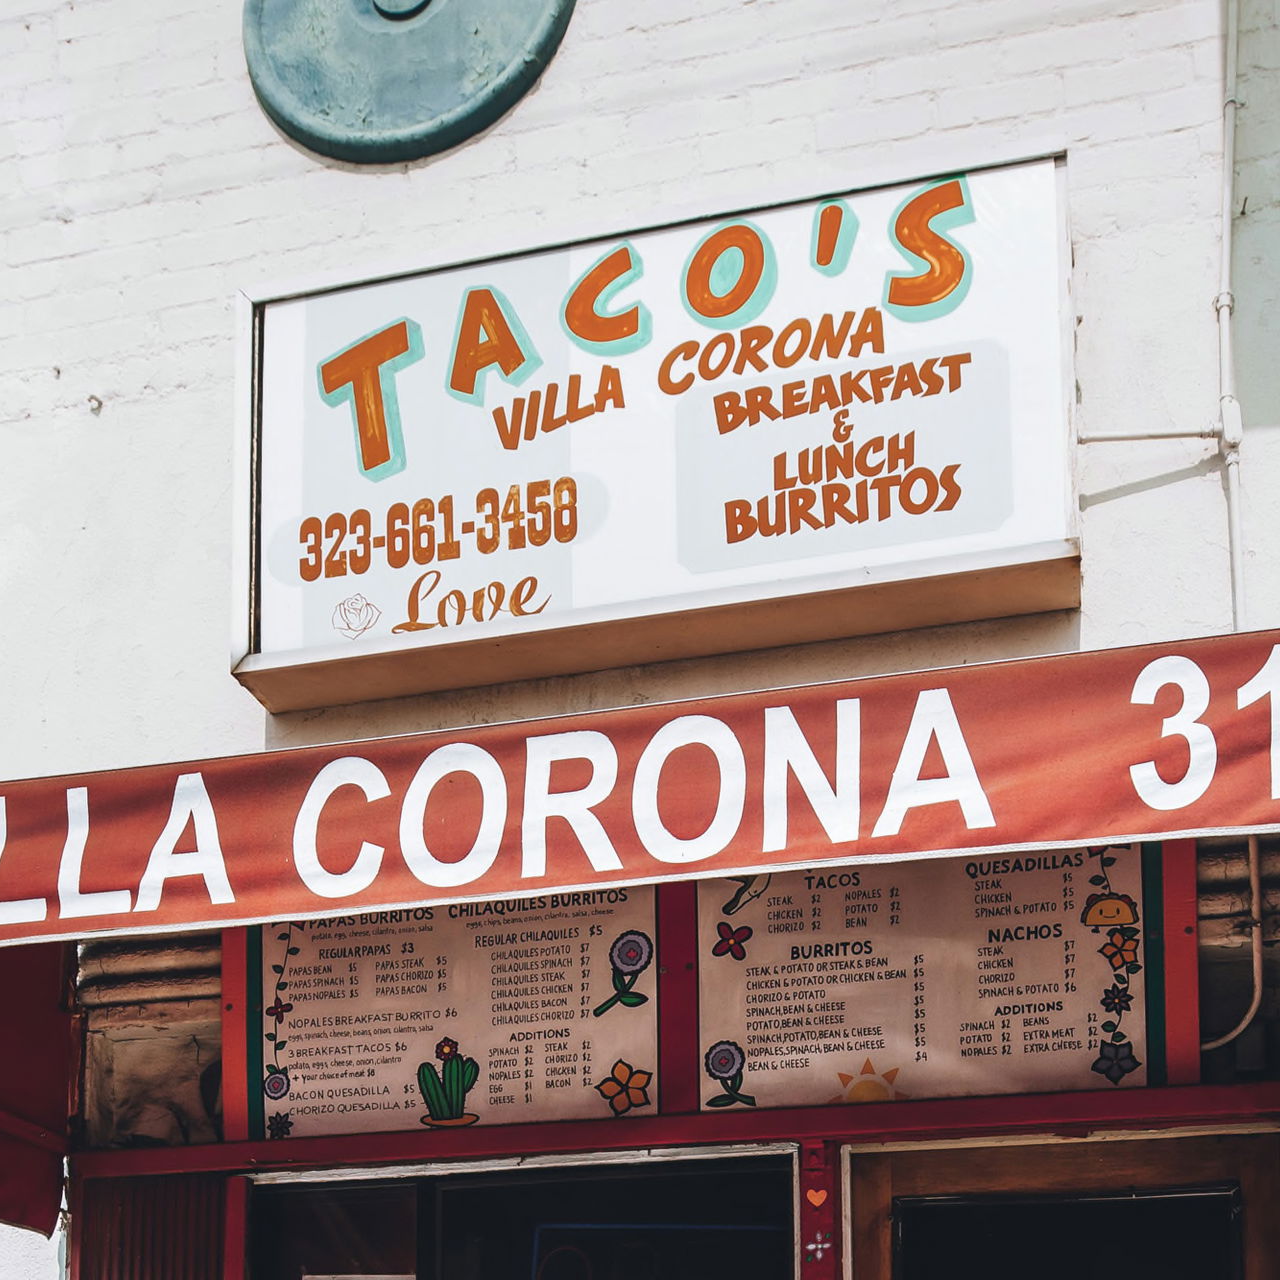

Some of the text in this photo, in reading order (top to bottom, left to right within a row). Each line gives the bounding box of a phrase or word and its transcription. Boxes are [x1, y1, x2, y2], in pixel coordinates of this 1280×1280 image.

[318, 172, 976, 482] TACO'S
[491, 306, 885, 451] VILLA CORONA
[713, 352, 971, 435] BREAKFAST
[832, 408, 854, 443] &
[774, 430, 915, 491] LUNCH
[724, 464, 962, 544] BURRITOS
[299, 476, 578, 582] 323-661-3458
[391, 570, 552, 635] Love
[291, 687, 997, 899] CORONA
[965, 852, 1084, 879] QUESADILLAS
[804, 872, 860, 890] TACOS
[975, 873, 1072, 891] STEAK $5
[767, 894, 820, 907] STEAK $2
[845, 887, 899, 901] NOPALES $2
[975, 887, 1074, 904] CHICKEN $5
[449, 889, 628, 918] CHILAQUILES BURRITOS
[845, 902, 900, 915] POTATO $2
[975, 901, 1074, 918] SPINACH & POTATO $5
[309, 908, 434, 929] PAPAS BURRITOS
[768, 908, 821, 920] CHICKEN $2
[846, 915, 899, 929] BEAN $2
[768, 921, 821, 934] CHORIZO $2
[988, 923, 1062, 943] NACHOS
[475, 925, 602, 948] REGULAR CHILAQUILES $5
[491, 943, 590, 960] CHILAQUILES POTATO $7
[791, 940, 873, 960] BURRITOS
[978, 941, 1075, 956] STEAK $7
[978, 954, 1075, 970] CHICKEN $7
[978, 968, 1075, 984] CHORIZO $7
[978, 982, 1076, 998] SPINACH & POTATO $6
[994, 1001, 1064, 1016] ADDITIONS
[289, 1007, 457, 1030] NOPALES BREAKFAST BURRITO $6
[510, 1028, 570, 1042] ADDITIONS
[288, 1042, 407, 1058] 3 BREAKFAST TACOS $6
[489, 1045, 534, 1057] SPINACH $2
[545, 1040, 591, 1052] STEAK $2
[489, 1057, 533, 1069] POTATO $2
[545, 1052, 591, 1064] CHORIZO $2
[489, 1069, 534, 1082] NOPALES $2
[546, 1065, 592, 1077] CHICKEN $2
[489, 1082, 532, 1094] EGG $1
[546, 1077, 593, 1088] BACON $2
[289, 1084, 415, 1102] BACON QUESADILLA $5
[489, 1094, 532, 1105] CHEESE $1
[289, 1100, 416, 1117] CHORIZO QUESADILLA $5
